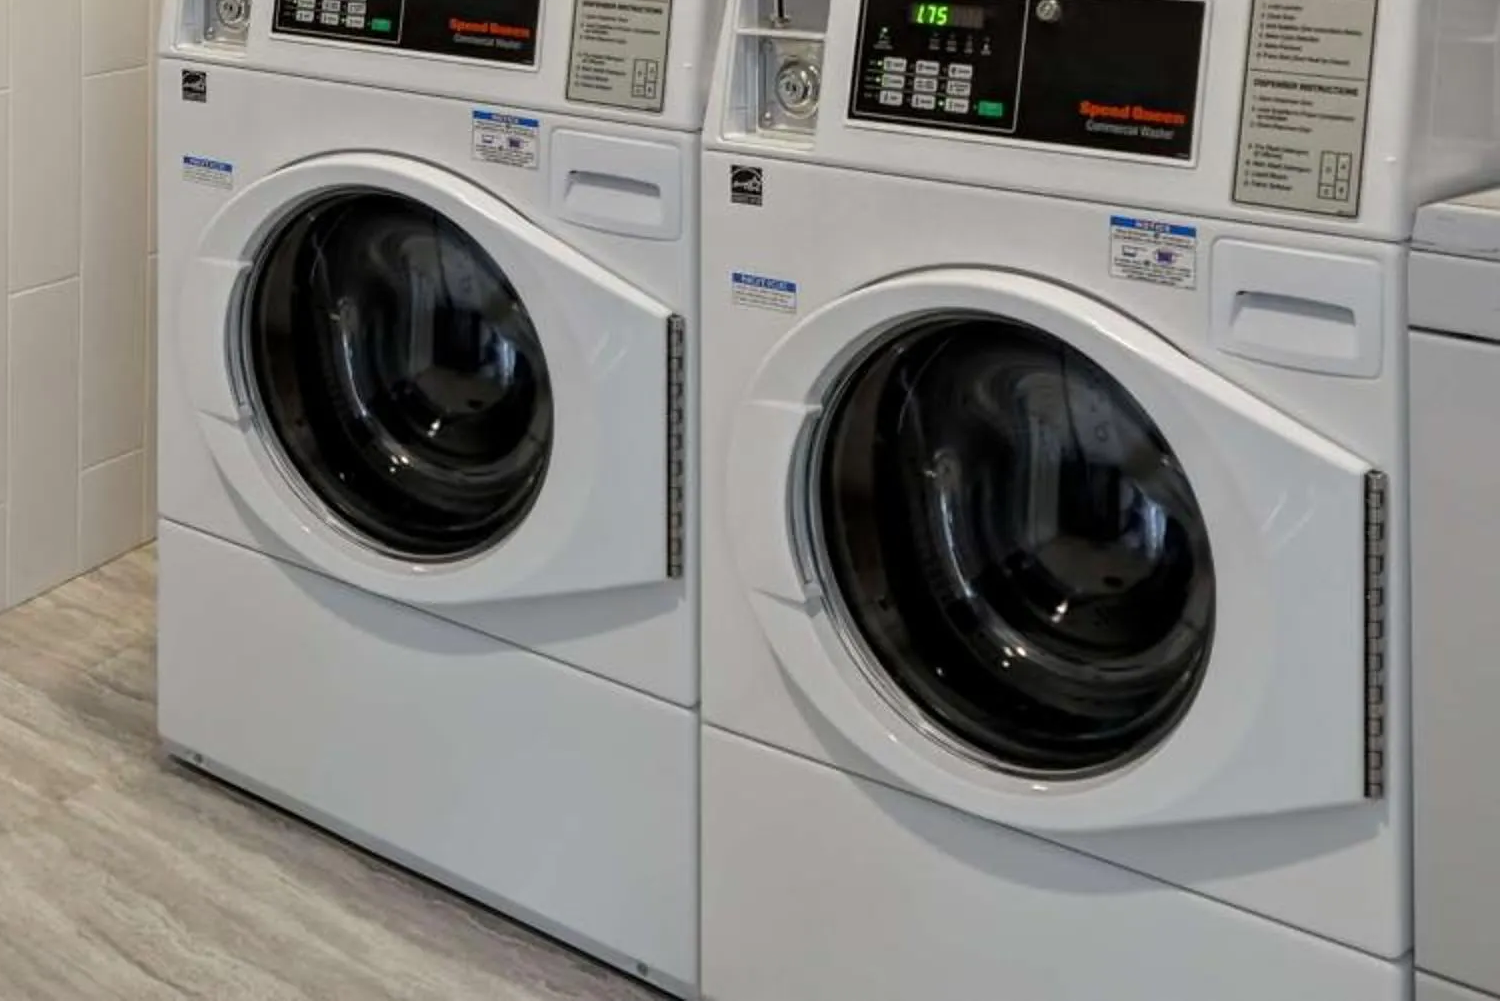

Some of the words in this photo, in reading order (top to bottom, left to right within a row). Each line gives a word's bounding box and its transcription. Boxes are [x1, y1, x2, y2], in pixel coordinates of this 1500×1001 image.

[1079, 100, 1129, 119] Speed
[1131, 105, 1185, 124] Queen
[1085, 119, 1138, 136] Commercial
[1141, 126, 1174, 140] Washer
